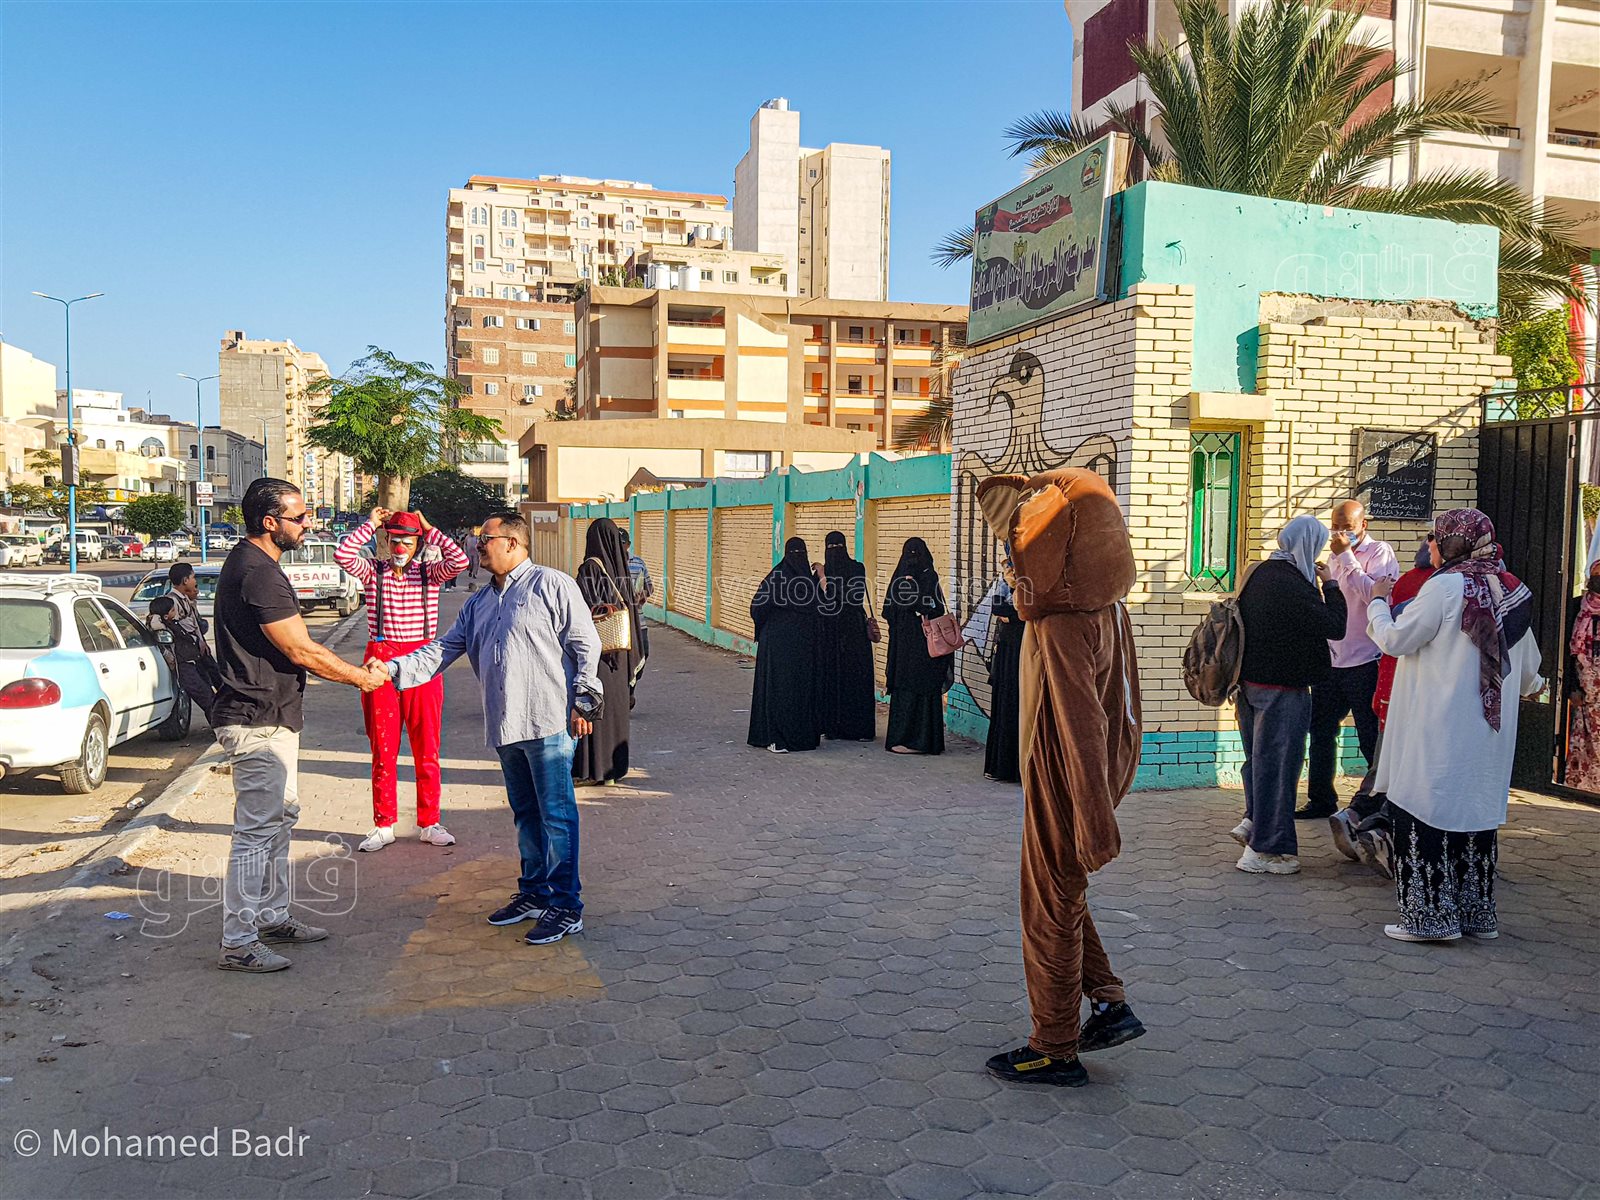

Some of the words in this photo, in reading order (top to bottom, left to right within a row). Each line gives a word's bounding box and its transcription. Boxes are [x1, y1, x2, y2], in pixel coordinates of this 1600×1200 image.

[1035, 182, 1054, 198] محافظة
[1015, 193, 1035, 212] مطروح
[1029, 205, 1047, 224] مطروح
[1065, 233, 1096, 284] مدرسة
[288, 573, 330, 582] ISSAN
